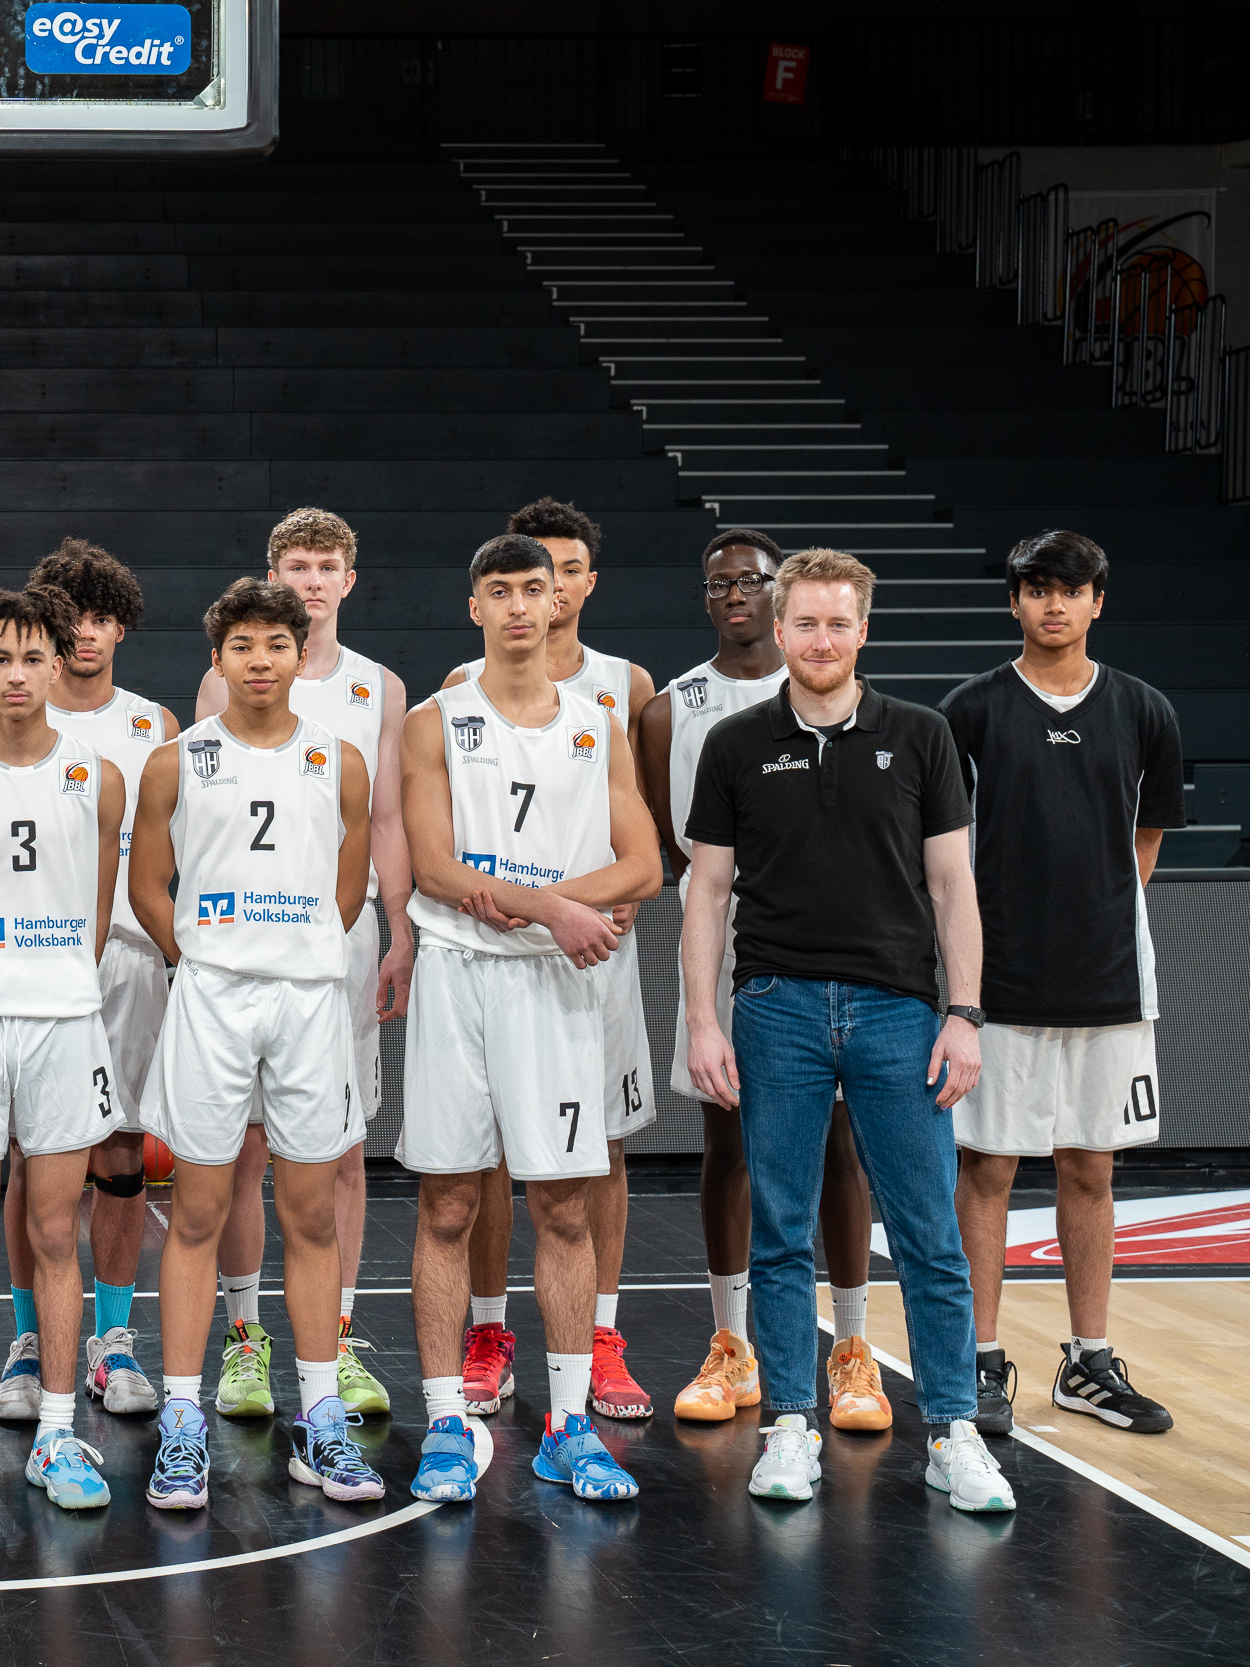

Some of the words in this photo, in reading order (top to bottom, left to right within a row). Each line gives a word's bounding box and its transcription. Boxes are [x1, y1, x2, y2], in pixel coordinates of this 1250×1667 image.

[771, 45, 806, 60] BLOCK
[775, 59, 797, 90] F
[684, 685, 705, 708] HH
[692, 703, 723, 719] SPALDING
[131, 726, 151, 739] JBBL
[457, 727, 480, 750] HH
[462, 755, 499, 767] SPALDING
[571, 746, 593, 759] JBBL
[194, 751, 218, 778] HH
[303, 761, 325, 776] JBBL
[762, 758, 810, 775] SPALDING
[63, 779, 86, 793] JBBL
[201, 776, 238, 789] SPALDING
[510, 780, 536, 833] 7
[250, 800, 276, 852] 2
[11, 819, 37, 873] 3
[499, 857, 565, 883] Hamburge
[243, 891, 320, 909] Hamburger
[14, 916, 87, 932] Hamburger
[243, 909, 312, 924] Volksbank
[13, 933, 83, 948] Volksbank
[92, 1066, 112, 1118] 3
[621, 1066, 643, 1118] 13
[559, 1101, 581, 1153] 7
